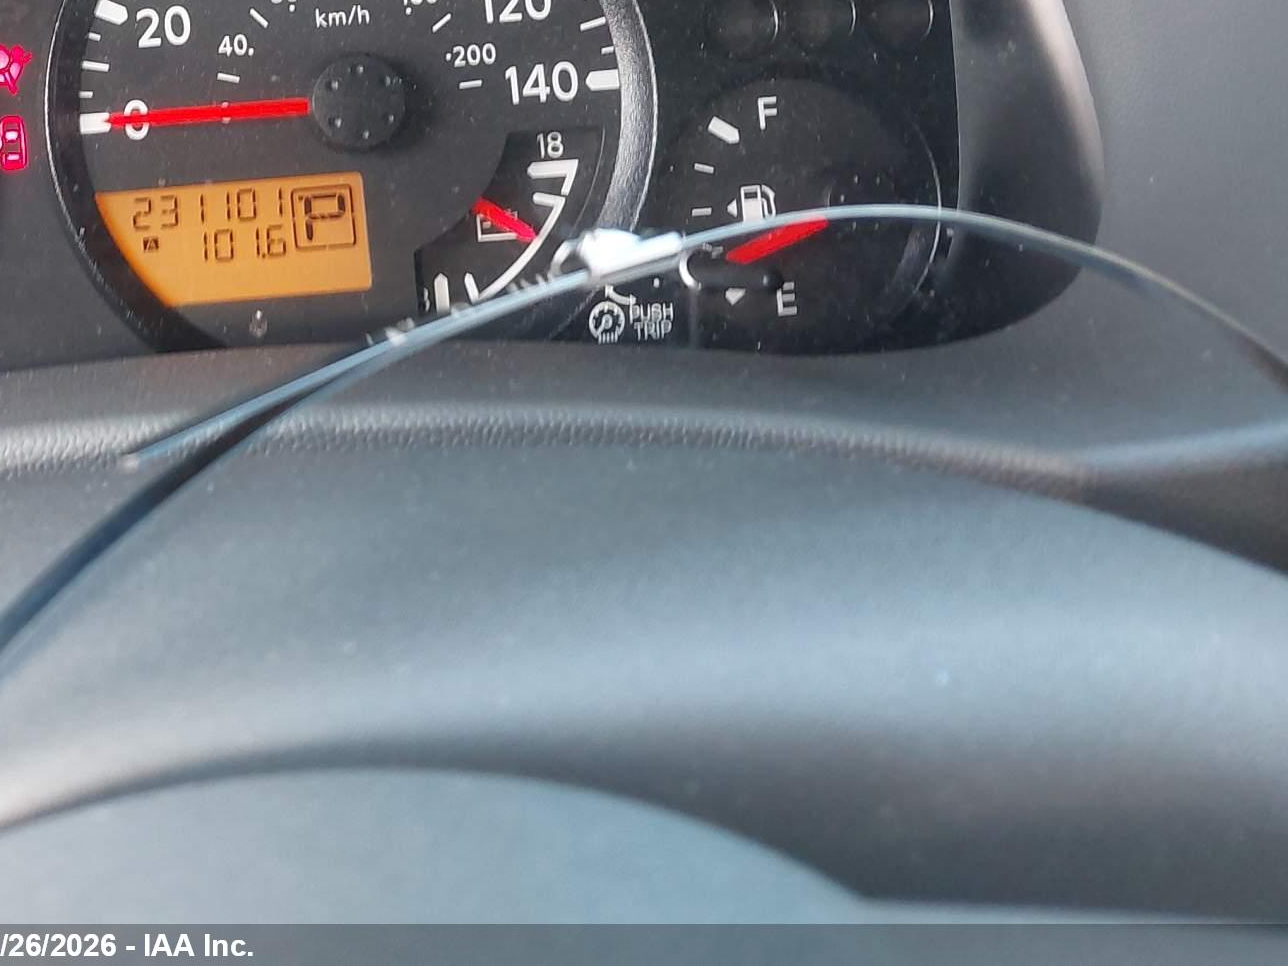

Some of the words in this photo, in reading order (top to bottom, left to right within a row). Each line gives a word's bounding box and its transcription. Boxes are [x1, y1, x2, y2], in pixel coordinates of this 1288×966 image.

[135, 5, 191, 49] 20
[315, 4, 370, 28] km/h
[505, 61, 579, 104] 140
[123, 99, 150, 141] 0
[758, 95, 778, 131] F
[537, 131, 563, 159] 18
[132, 186, 284, 231] 231101
[304, 192, 346, 242] P
[203, 224, 287, 263] 101.6
[629, 302, 673, 325] PUSH
[776, 281, 798, 317] E
[633, 319, 672, 341] TRIP
